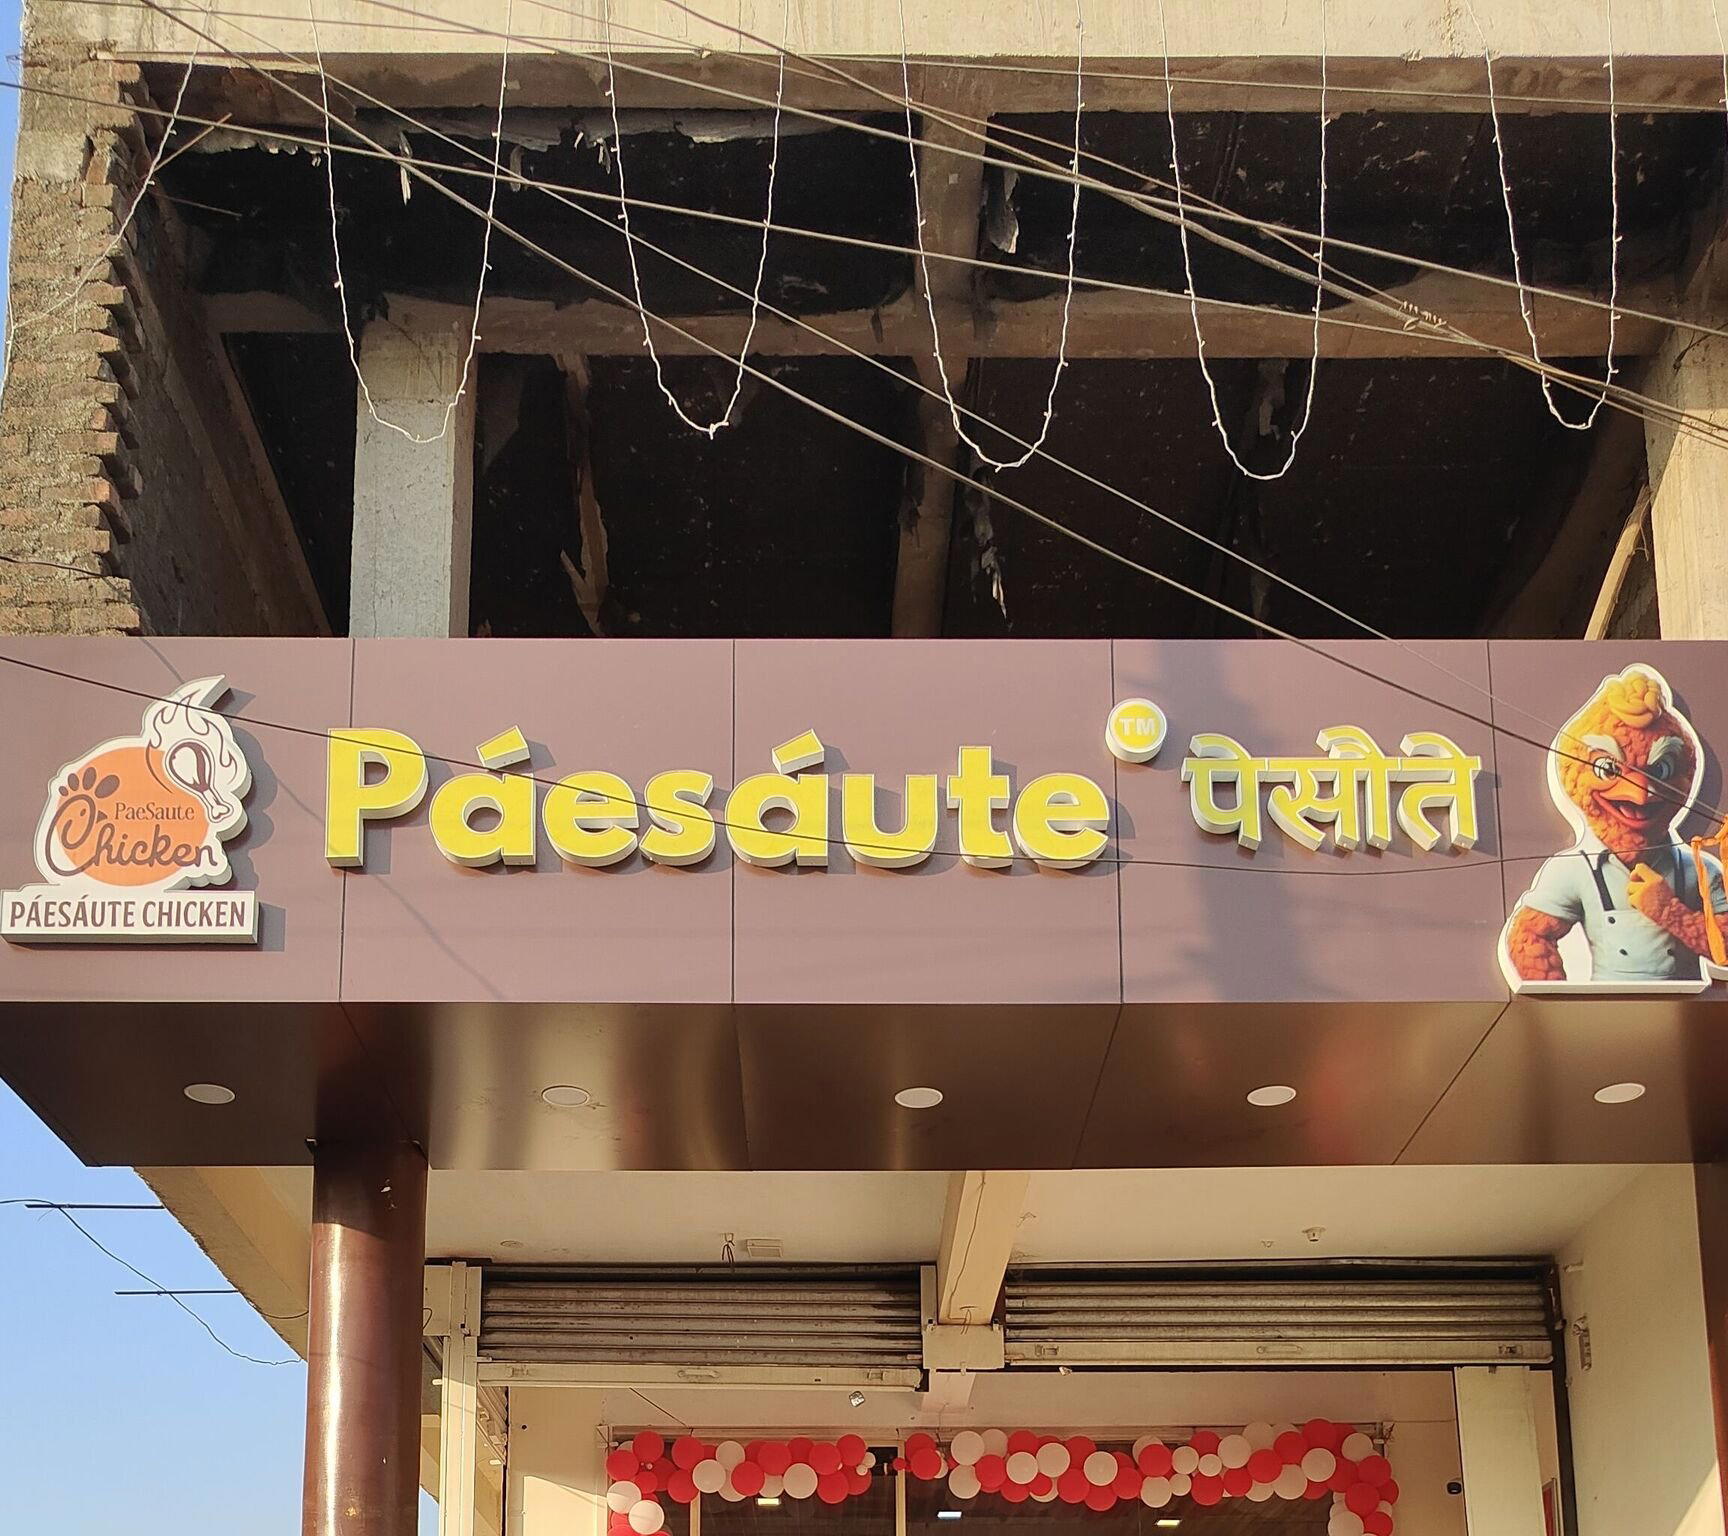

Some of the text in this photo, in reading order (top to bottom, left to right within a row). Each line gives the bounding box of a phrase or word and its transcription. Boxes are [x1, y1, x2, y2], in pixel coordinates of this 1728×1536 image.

[114, 802, 195, 821] PaeSaute
[326, 717, 1157, 869] Páesáute TM
[45, 794, 218, 876] Chicken
[142, 900, 246, 928] CHICKEN
